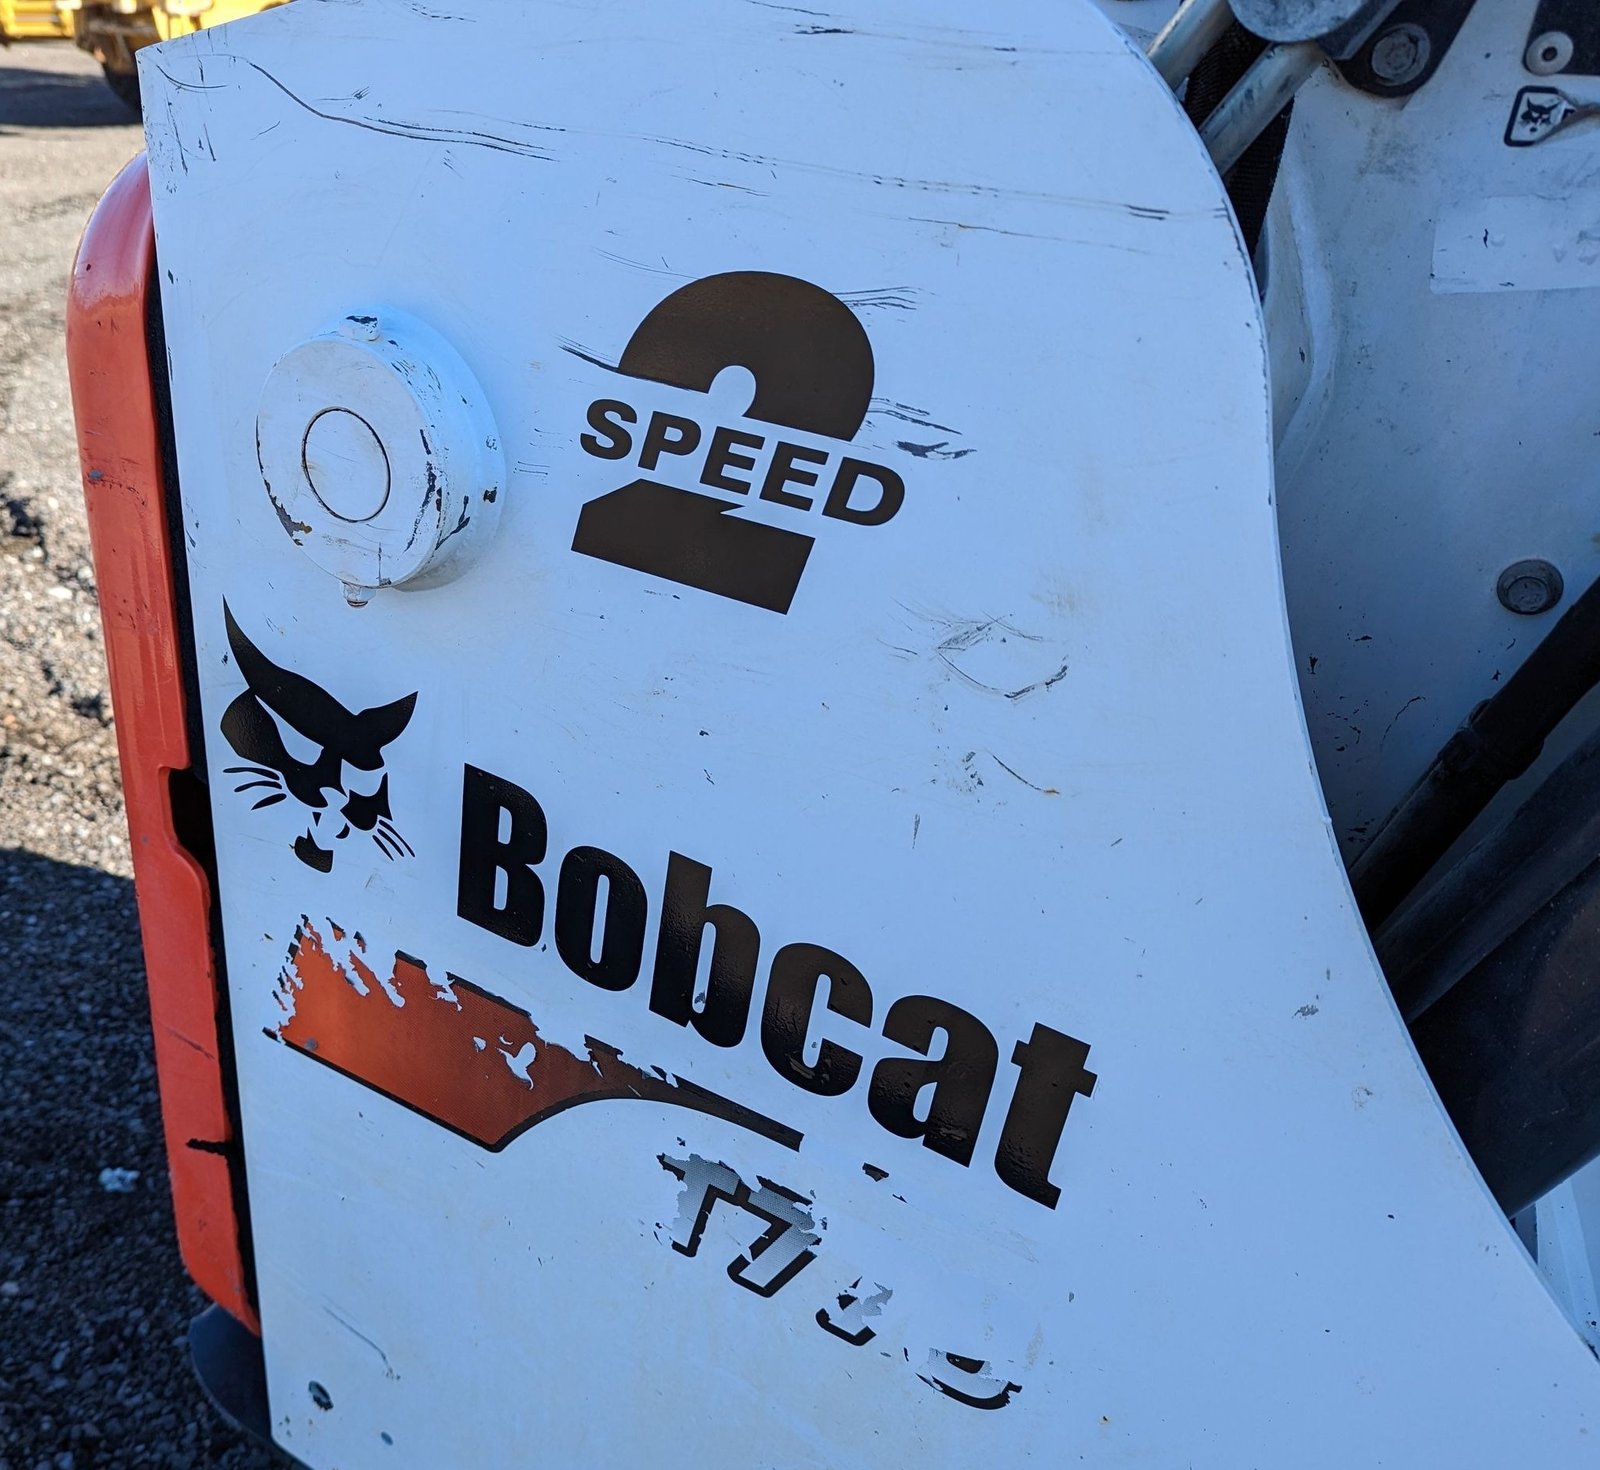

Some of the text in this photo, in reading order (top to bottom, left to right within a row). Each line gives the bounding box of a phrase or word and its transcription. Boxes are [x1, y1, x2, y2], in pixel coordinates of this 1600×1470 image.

[571, 271, 875, 615] 2
[580, 398, 906, 527] SPEED
[457, 763, 1098, 1210] Bobcat
